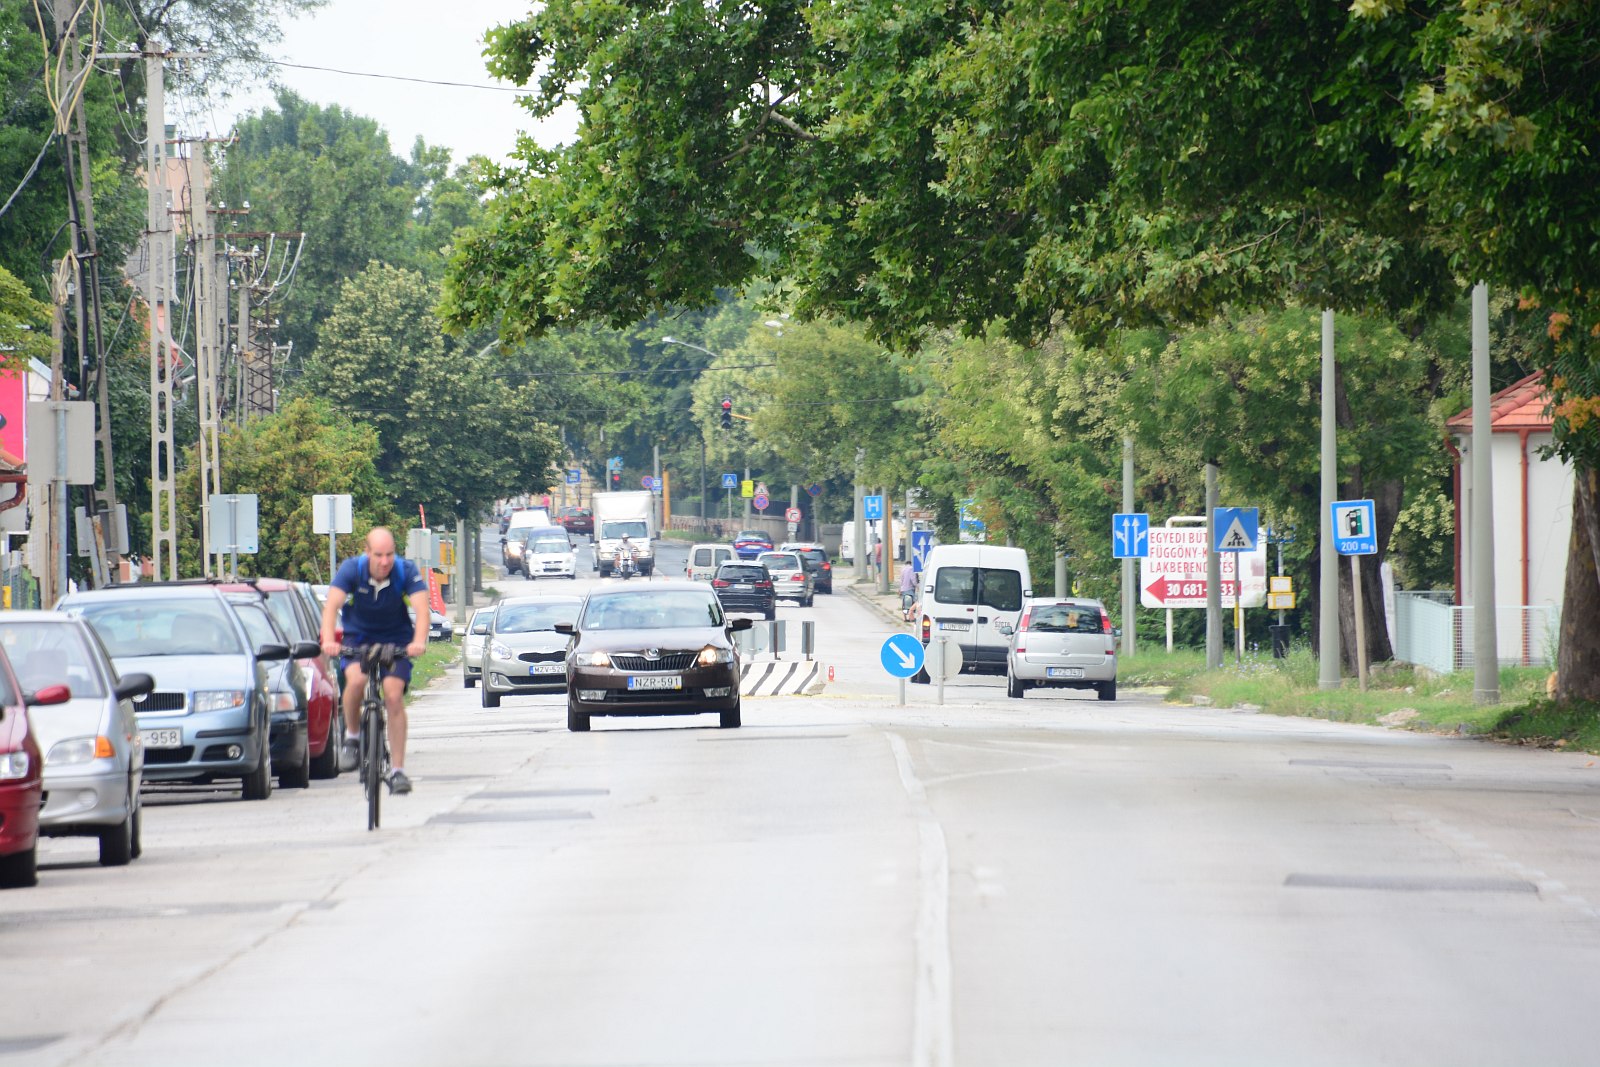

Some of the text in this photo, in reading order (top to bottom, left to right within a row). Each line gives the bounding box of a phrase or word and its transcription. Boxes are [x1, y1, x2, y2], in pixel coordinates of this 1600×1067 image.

[1150, 532, 1185, 543] EGYEDI
[1341, 541, 1358, 551] 200
[1166, 583, 1181, 596] 30
[636, 677, 678, 687] NZR-591
